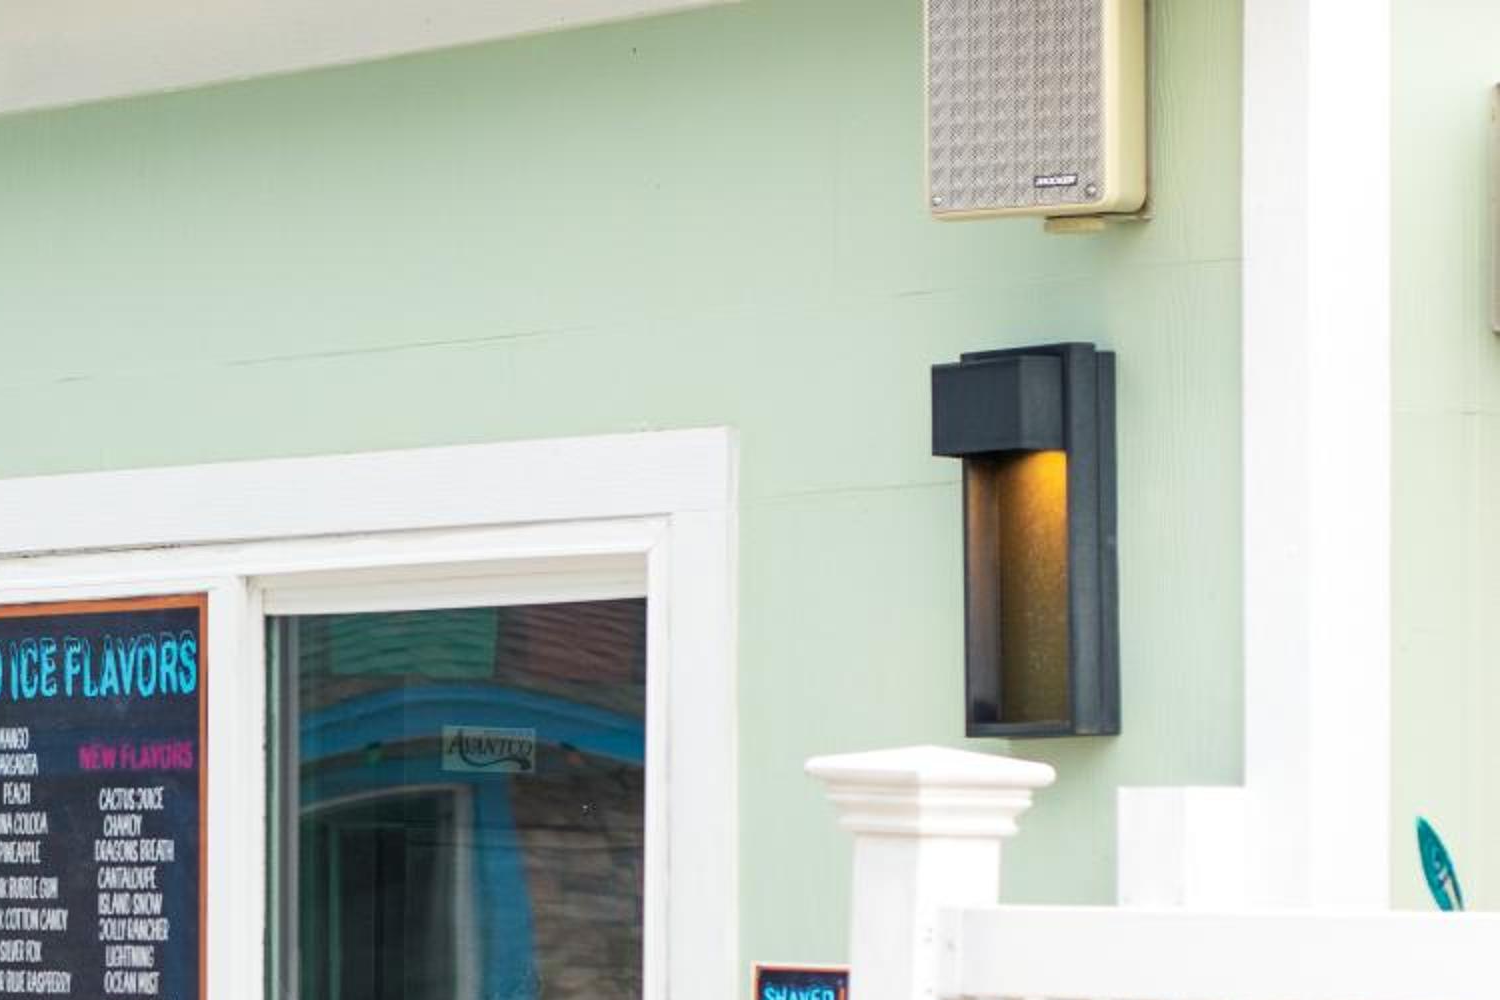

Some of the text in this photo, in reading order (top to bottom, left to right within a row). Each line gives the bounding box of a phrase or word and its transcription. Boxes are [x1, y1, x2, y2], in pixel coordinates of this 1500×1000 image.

[9, 640, 57, 699] ICE
[65, 634, 196, 697] FLAVORS
[79, 738, 194, 769] NEW FLAVORS
[3, 782, 31, 805] PEACH
[99, 786, 165, 811] CACTUS JUICE
[103, 814, 143, 838] CHAMOY
[94, 839, 175, 862] DRAGONS BREATH
[9, 876, 38, 899] BUBBLE
[39, 876, 59, 899] GUM
[97, 866, 157, 890] CANTALOUPE
[97, 892, 164, 916] ISLAND SNOW
[5, 907, 39, 931] COTTON
[40, 907, 69, 931] CANDY
[98, 917, 170, 942] JOLLY RANCHER
[0, 939, 43, 963] SILVER FOX
[105, 944, 155, 968] LIGHTNING
[6, 969, 25, 994] BLUE
[26, 969, 72, 994] RASPBERRY
[103, 971, 161, 996] OCEAN MIST
